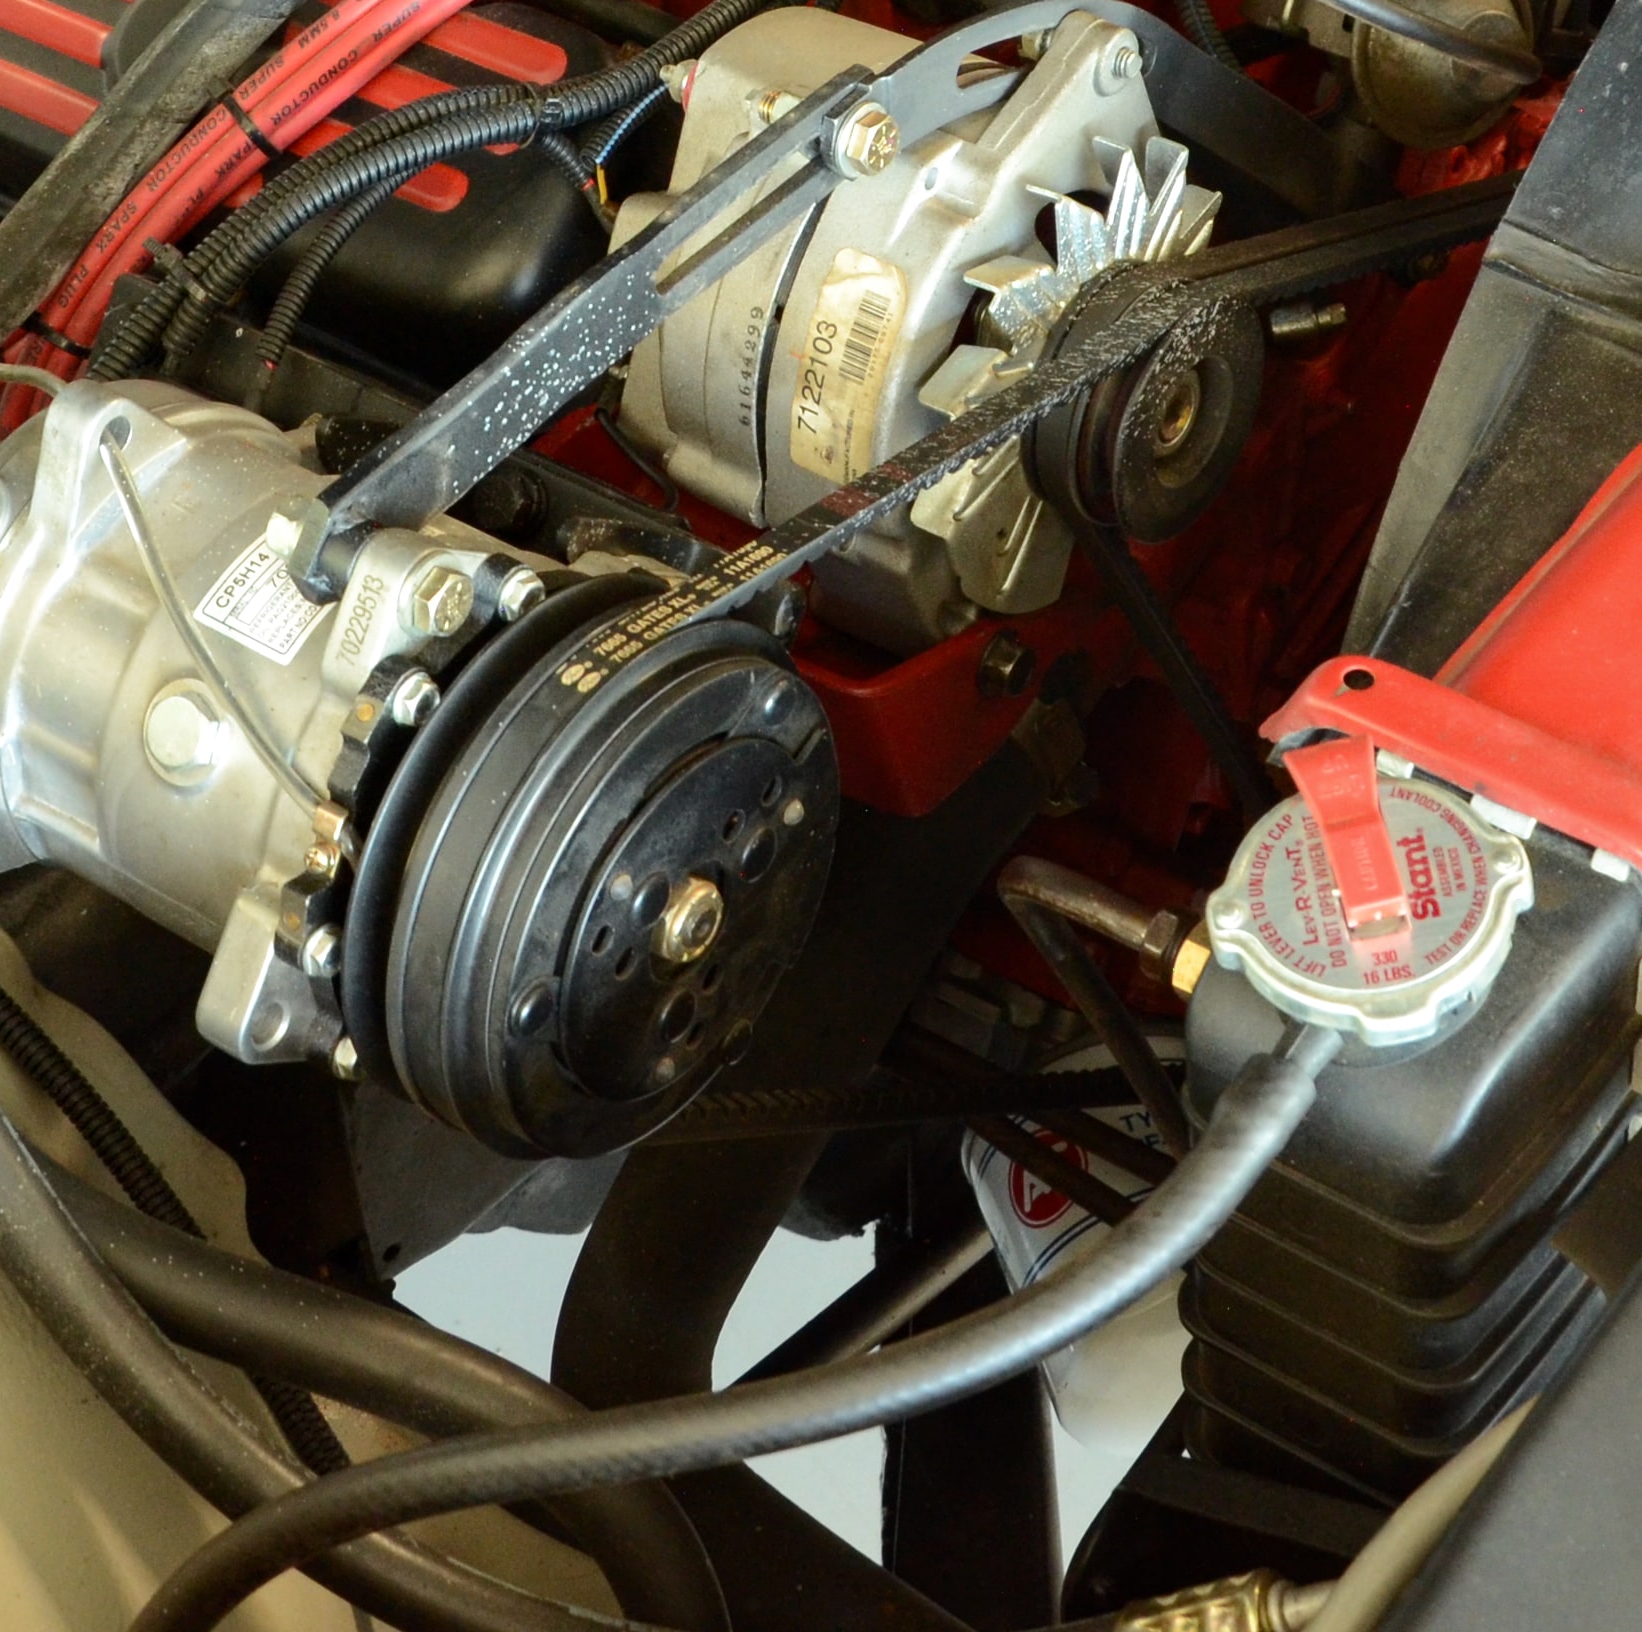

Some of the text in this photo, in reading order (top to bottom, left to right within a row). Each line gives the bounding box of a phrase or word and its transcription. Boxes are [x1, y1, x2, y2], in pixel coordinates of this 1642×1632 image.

[297, 10, 341, 50] 8.5MM
[369, 0, 423, 44] SUPER
[237, 55, 284, 101] SUPER
[270, 49, 358, 126] CONDUCTOR
[145, 108, 228, 193] CONDUCTOR
[95, 201, 138, 255] SPARK
[58, 265, 88, 310] PLUG
[797, 319, 838, 434] 7122103
[216, 552, 270, 608] CP5H14
[279, 629, 296, 649] PART
[335, 574, 384, 666] 70229513
[627, 603, 672, 635] GATES
[1389, 787, 1487, 966] TEST OR REPLACE WHEN CHANGING COOLANT
[1396, 835, 1440, 920] Stant
[1433, 845, 1453, 897] ASSEMBLED
[1447, 846, 1465, 881] MEXICO
[1249, 813, 1326, 979] LIFT LEVER TO UNLOCK CAP
[1302, 815, 1348, 968] DO NOT OPEN WHEN HOT
[1363, 965, 1416, 985] 16 LBS.
[1371, 948, 1398, 966] 330
